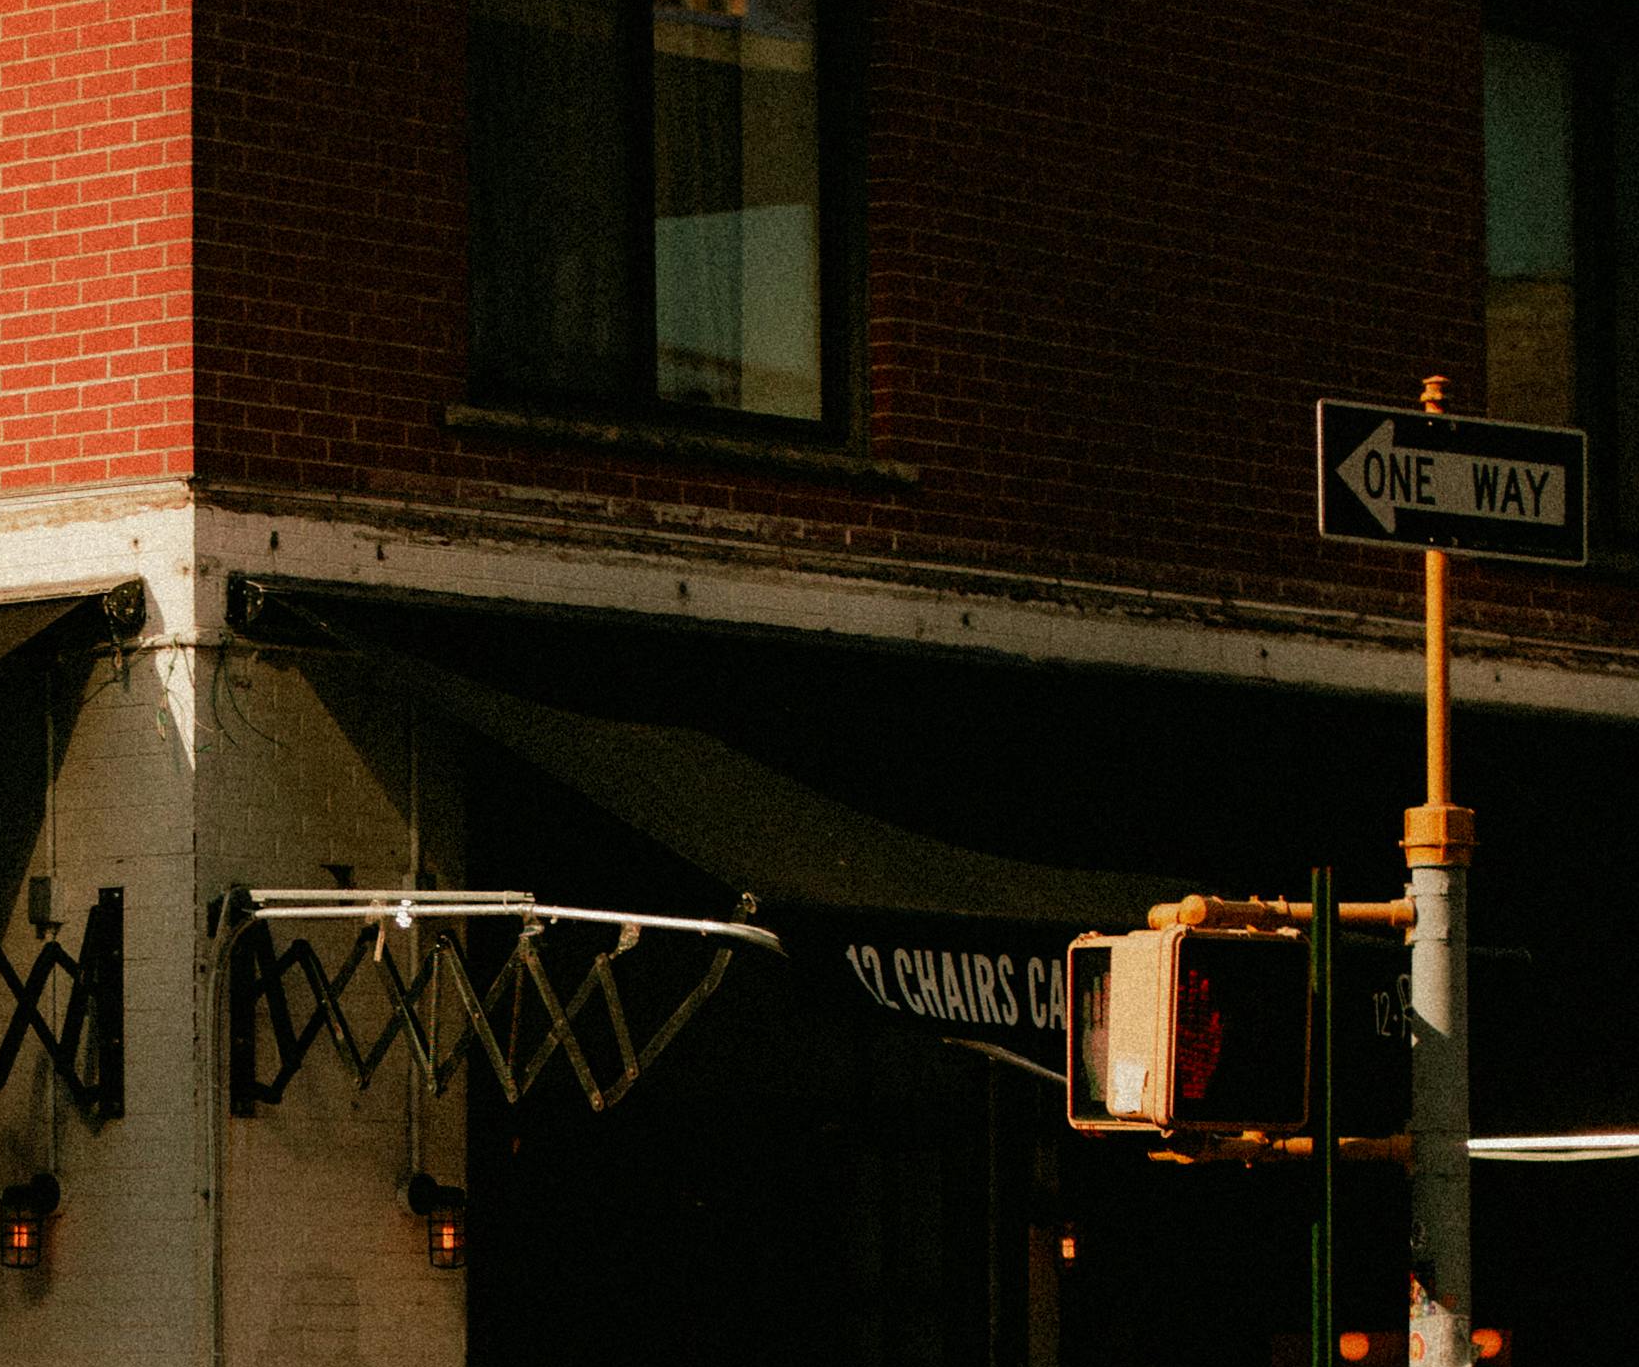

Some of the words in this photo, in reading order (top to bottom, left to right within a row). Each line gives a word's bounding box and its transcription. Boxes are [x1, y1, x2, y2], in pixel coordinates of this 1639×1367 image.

[1363, 449, 1436, 505] ONE
[1472, 462, 1549, 517] WAY
[845, 944, 901, 1011] 12
[893, 947, 1020, 1027] CHAIRS
[1027, 956, 1068, 1031] CA
